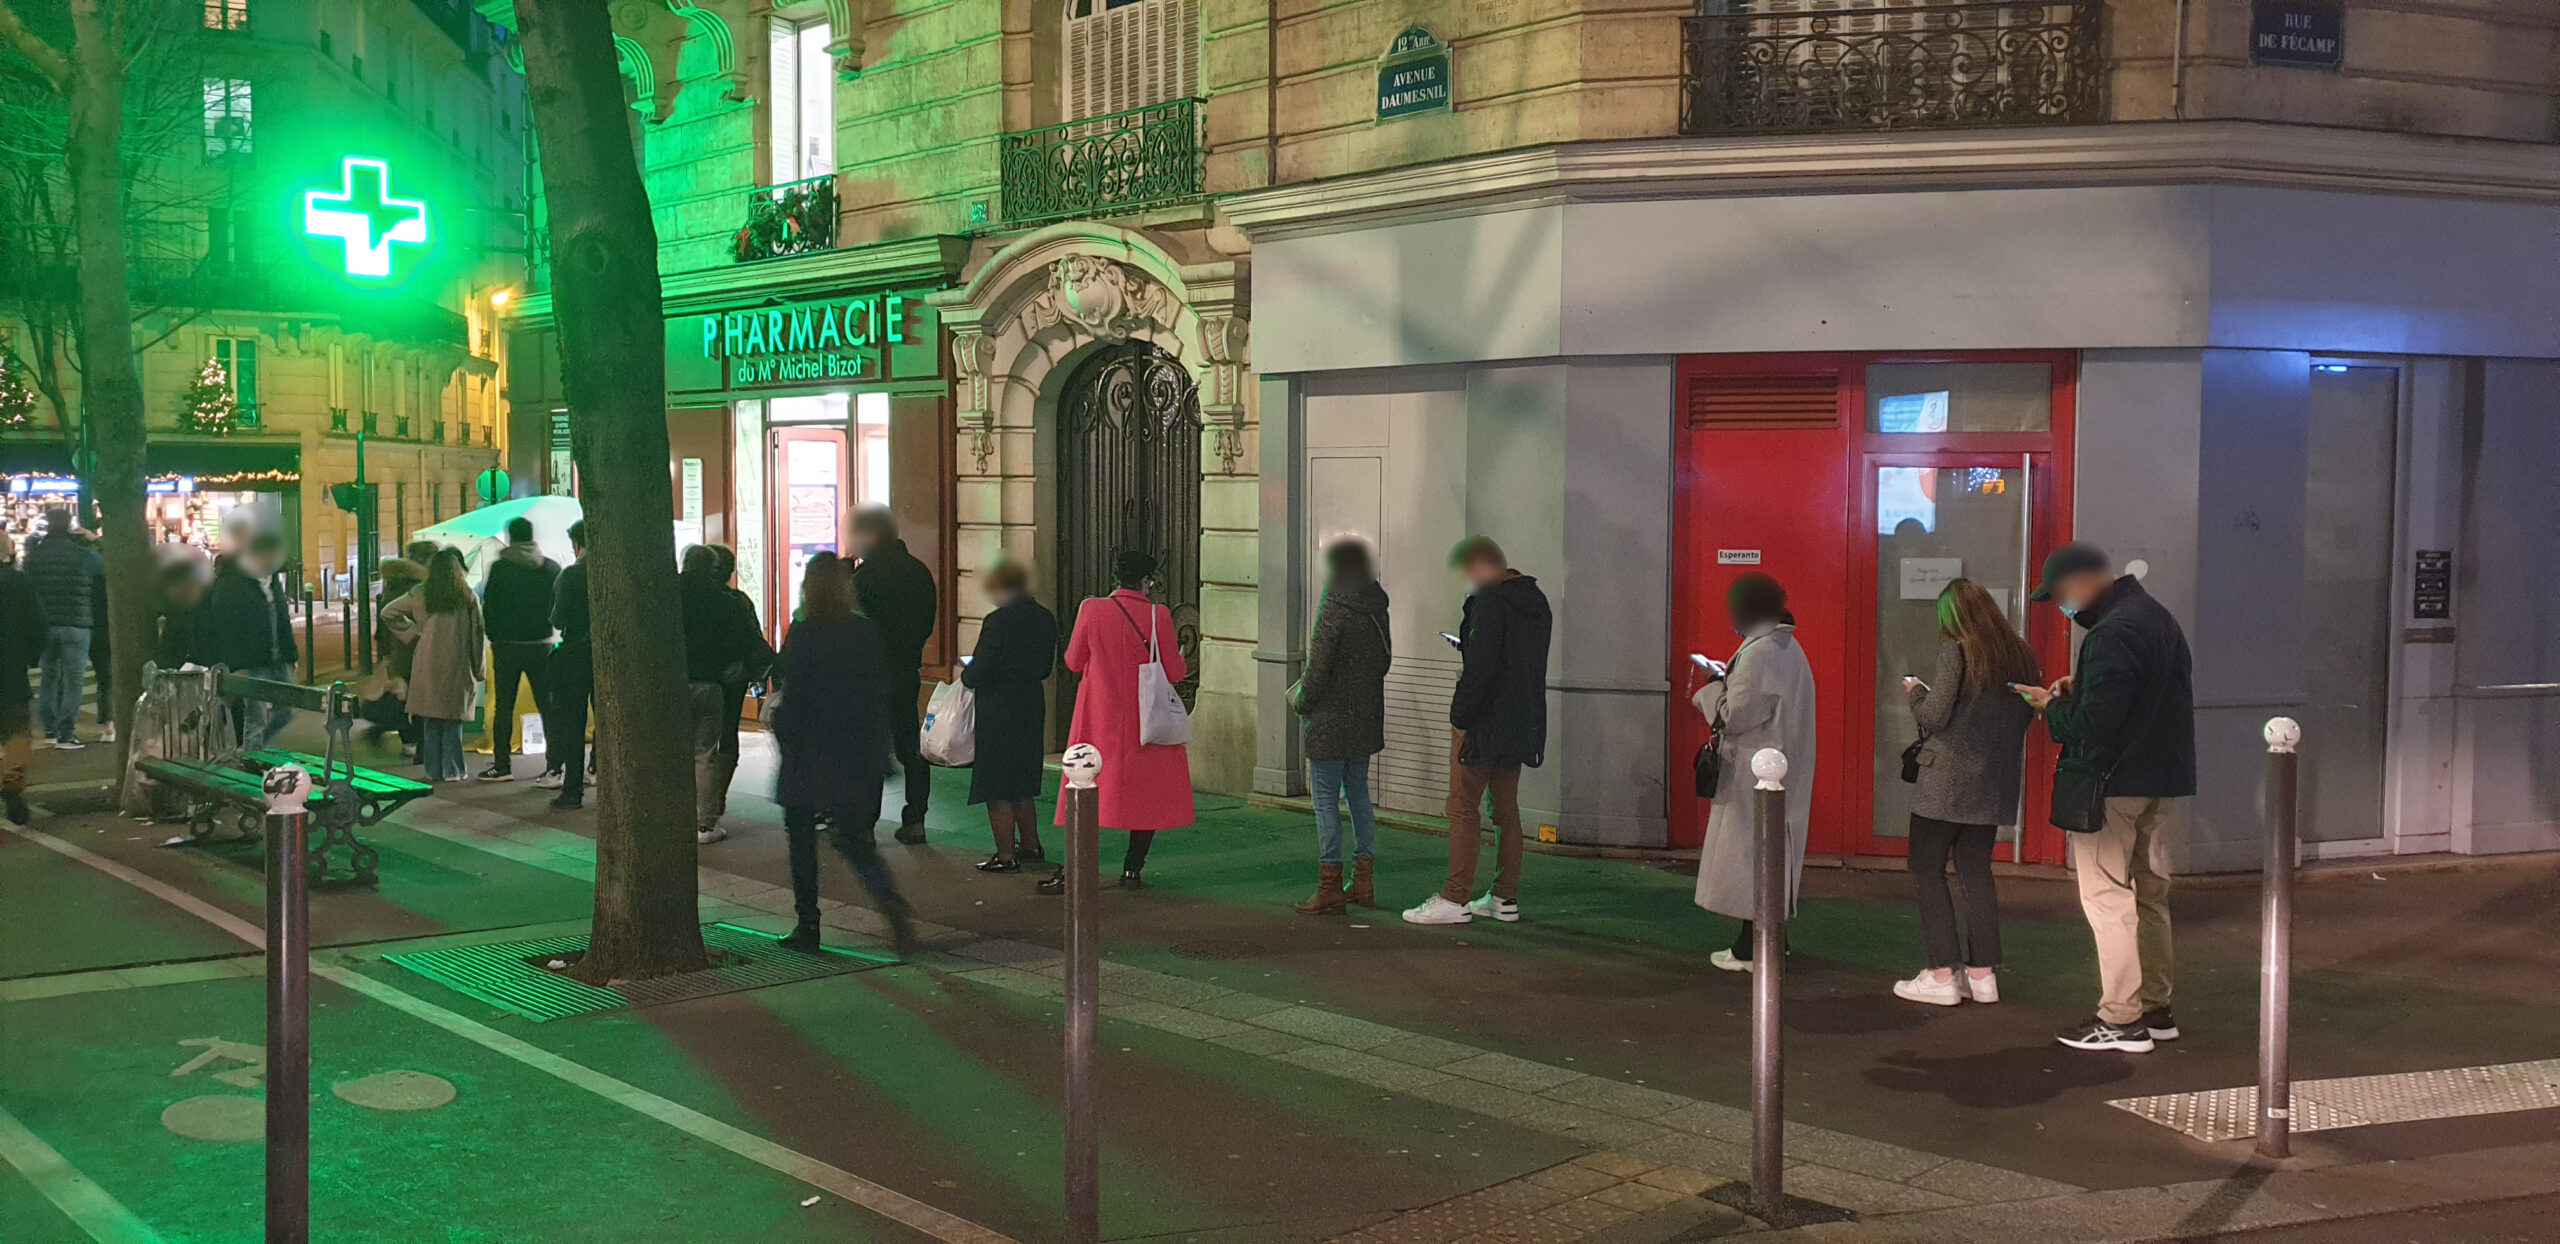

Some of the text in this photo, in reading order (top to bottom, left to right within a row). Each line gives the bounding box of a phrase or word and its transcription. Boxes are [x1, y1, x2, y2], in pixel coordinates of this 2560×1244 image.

[2285, 13, 2312, 29] RUE
[2259, 32, 2336, 53] DE FÉCAMP
[1393, 66, 1436, 87] AVENUE
[1381, 85, 1446, 109] DAUMESNIL
[704, 296, 903, 358] PHARMACIE
[739, 360, 754, 382] du
[779, 353, 823, 380] Michel
[828, 353, 862, 377] Bizot
[1719, 551, 1760, 560] Esperanto
